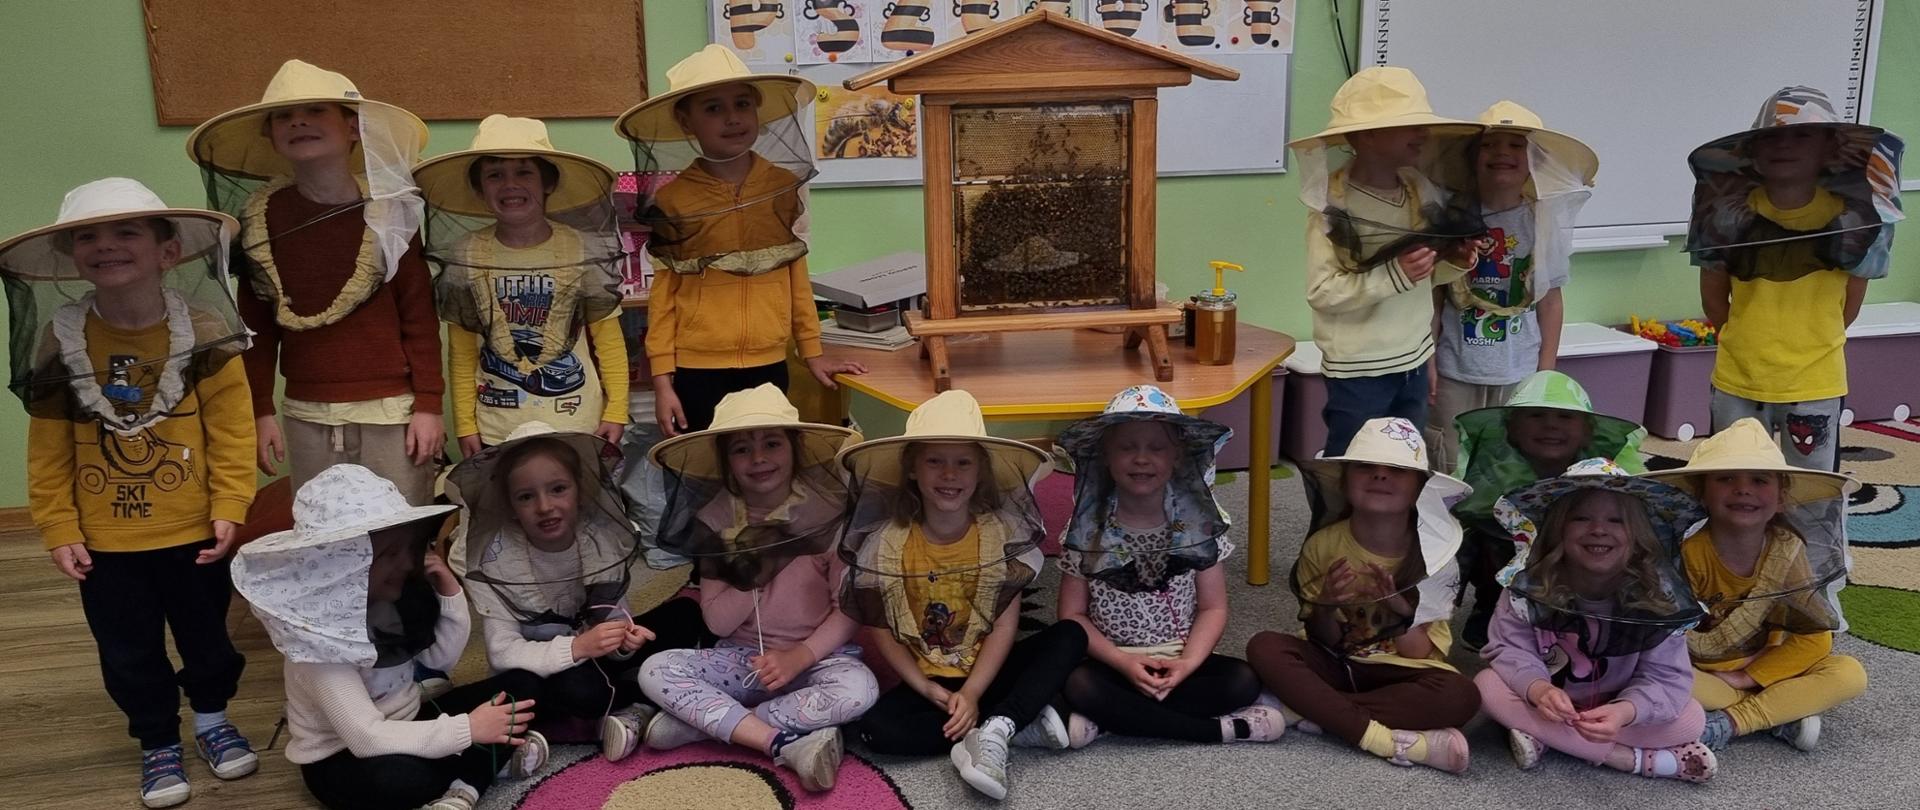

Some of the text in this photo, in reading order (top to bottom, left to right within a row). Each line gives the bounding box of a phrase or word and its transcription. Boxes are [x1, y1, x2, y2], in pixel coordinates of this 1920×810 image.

[1472, 276, 1501, 284] MARIO
[1466, 337, 1496, 346] YOSHI
[117, 484, 146, 501] SKI
[111, 502, 152, 519] TIME
